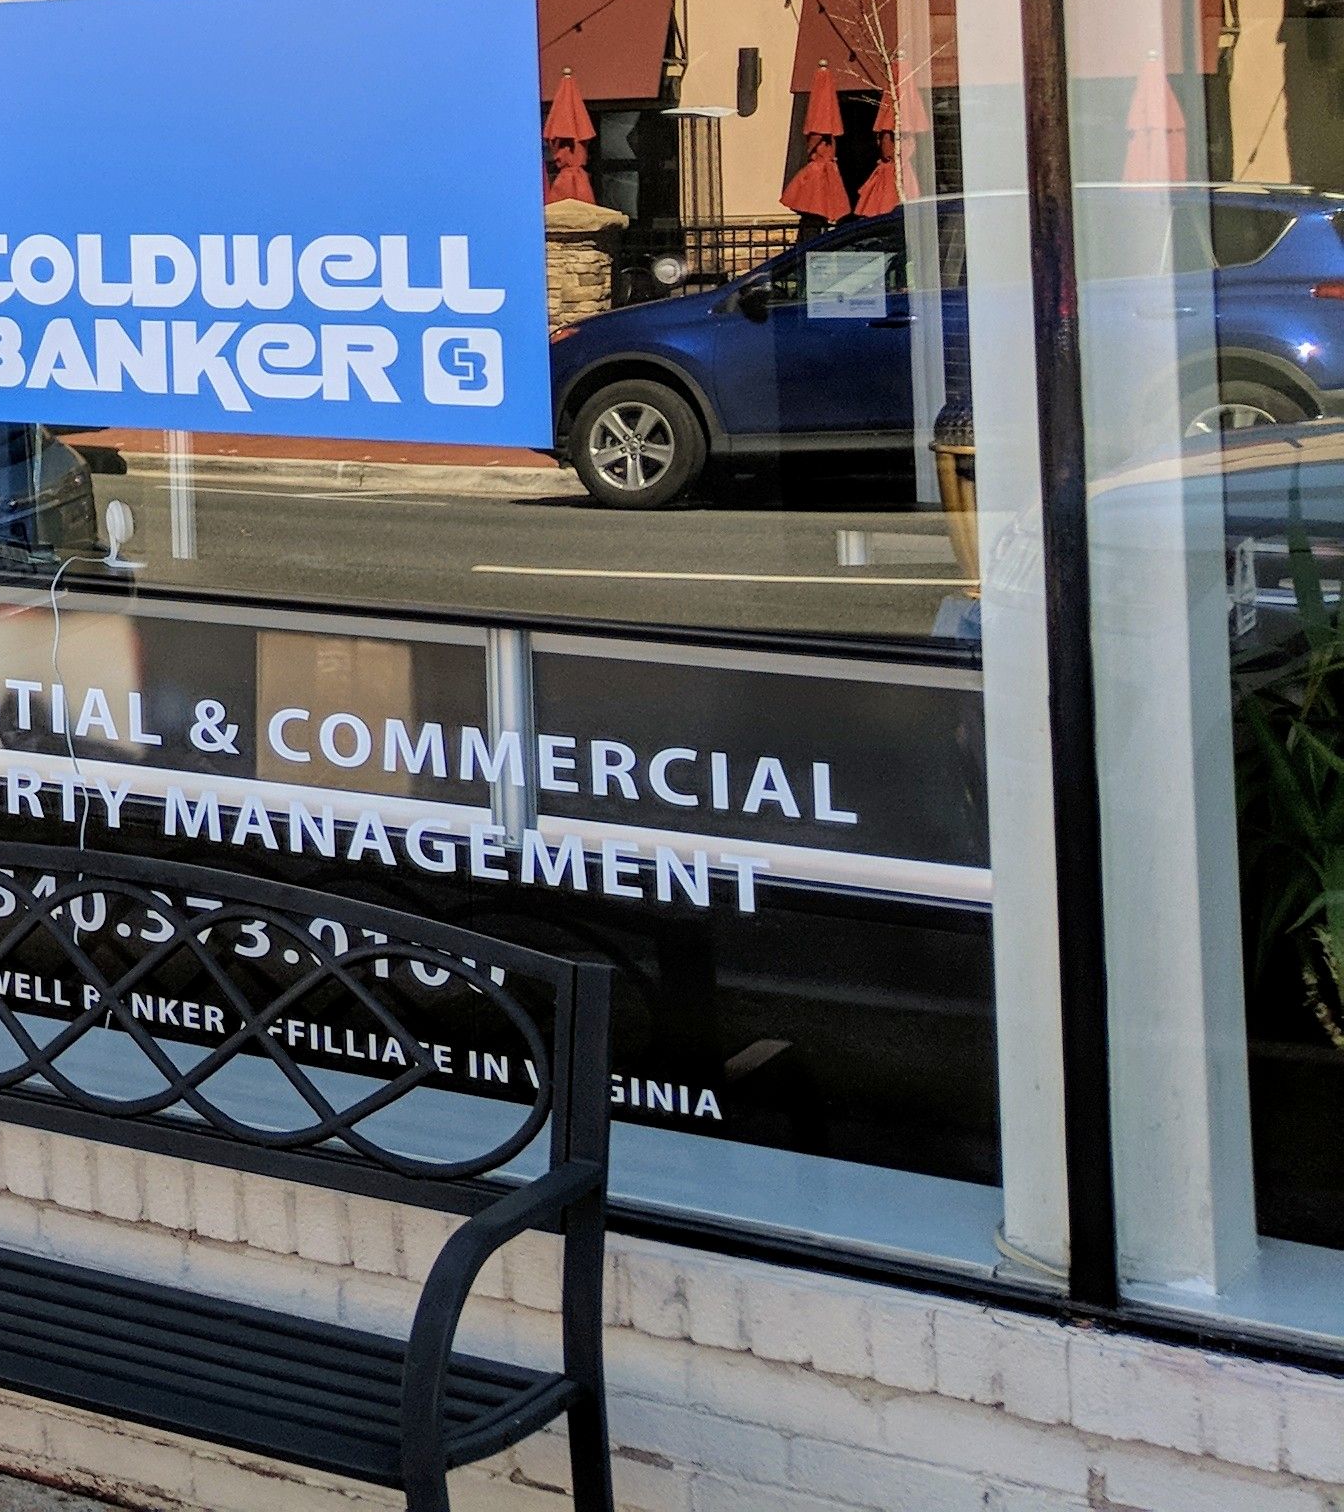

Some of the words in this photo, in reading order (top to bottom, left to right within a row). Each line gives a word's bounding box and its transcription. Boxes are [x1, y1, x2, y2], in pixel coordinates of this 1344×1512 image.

[189, 698, 241, 756] &
[267, 707, 858, 826] COMMERCIAL
[162, 784, 770, 914] MANAGEMENT
[83, 984, 226, 1035] BNKER
[240, 1018, 454, 1074] FILLIAE
[468, 1050, 509, 1084] IN
[524, 1058, 724, 1120] VGINIA
